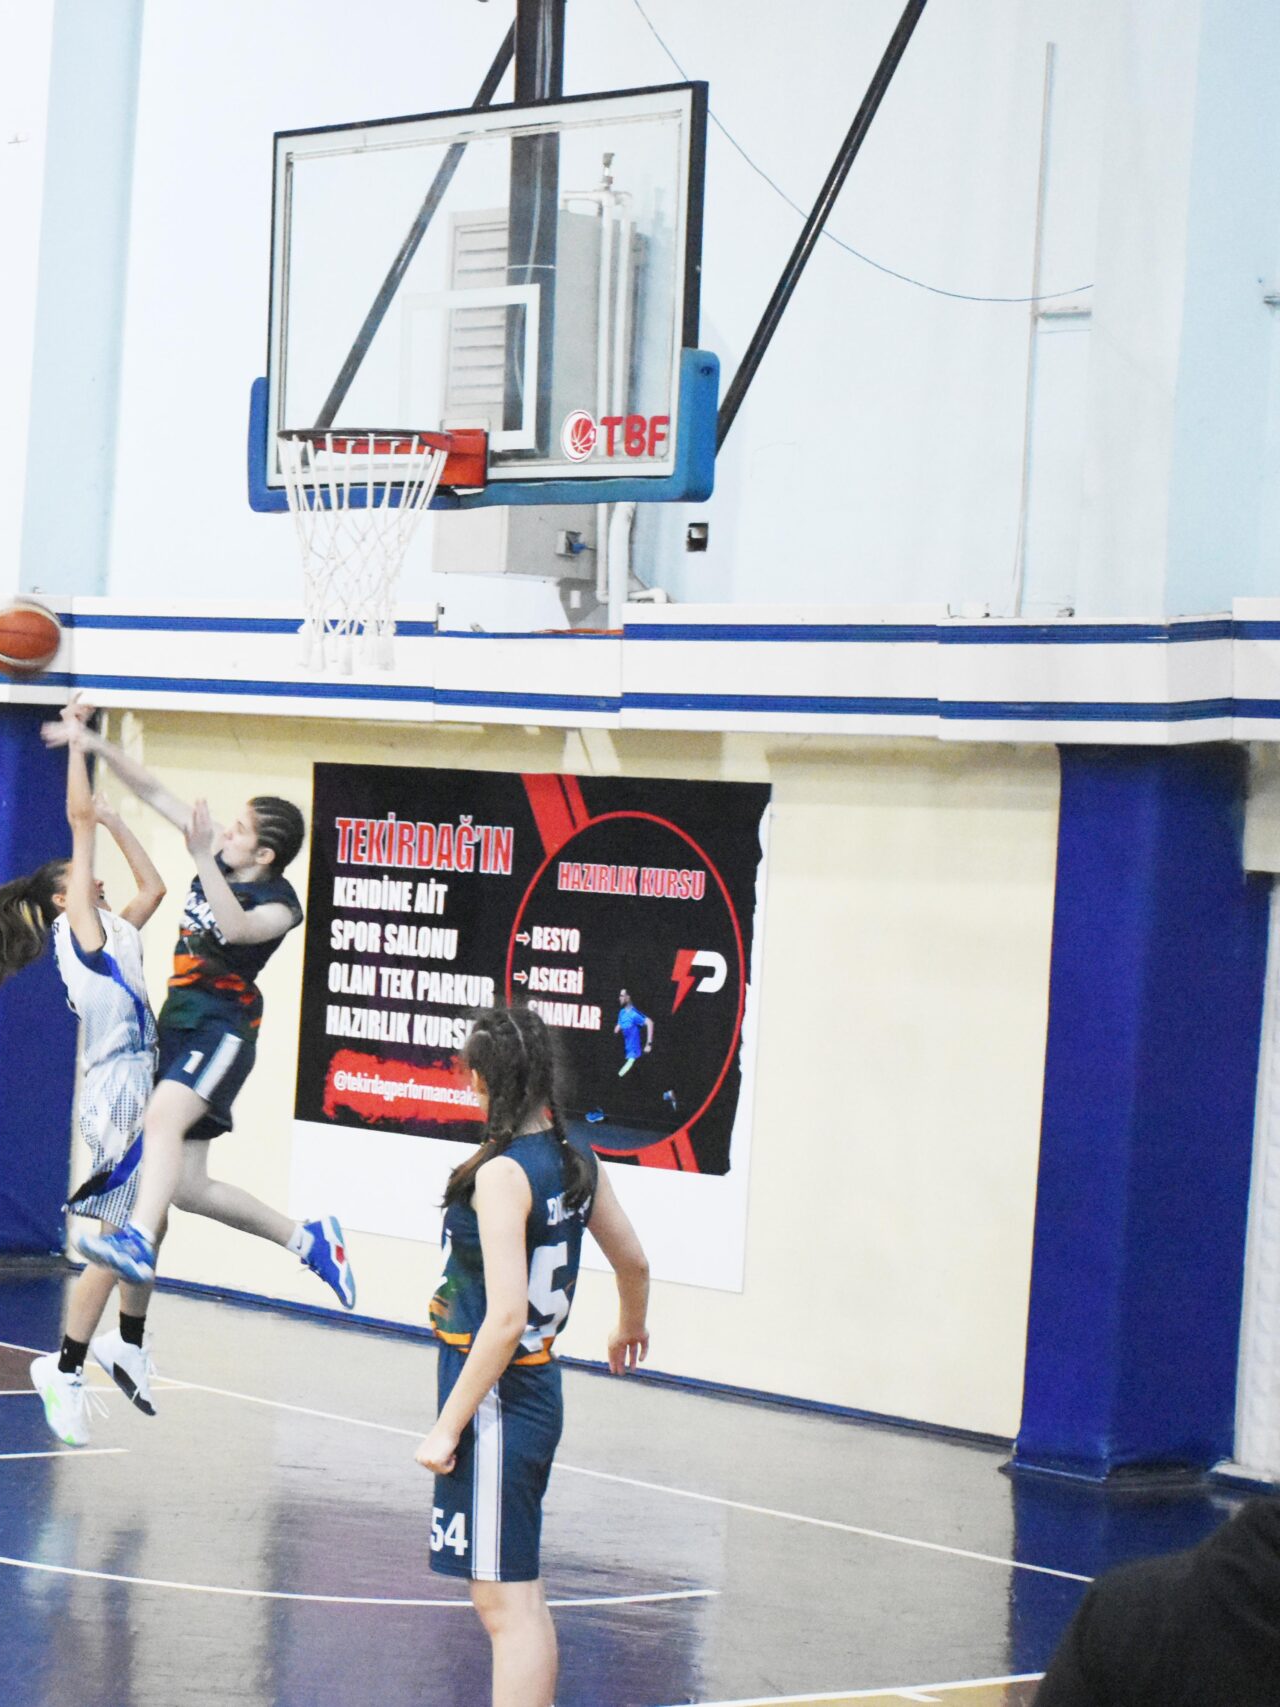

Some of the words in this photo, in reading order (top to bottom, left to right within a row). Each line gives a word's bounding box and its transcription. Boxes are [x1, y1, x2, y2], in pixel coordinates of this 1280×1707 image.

[600, 415, 670, 457] TBF
[336, 812, 514, 875] TEKİRDAĞ'IN
[333, 875, 412, 912] KENDİNE
[414, 878, 448, 915] AİT
[558, 862, 638, 895] HAZIRLIK
[639, 867, 706, 900] KURSU
[330, 919, 381, 953] SPOR
[384, 923, 458, 960] SALONU
[531, 926, 581, 953] BESYO
[327, 962, 376, 996] OLAN
[379, 966, 415, 1000] TEK
[416, 970, 495, 1008] PARKUR
[528, 966, 584, 994] ASKERİ
[325, 1005, 411, 1044] HAZIRLIK
[429, 1506, 468, 1556] 54
